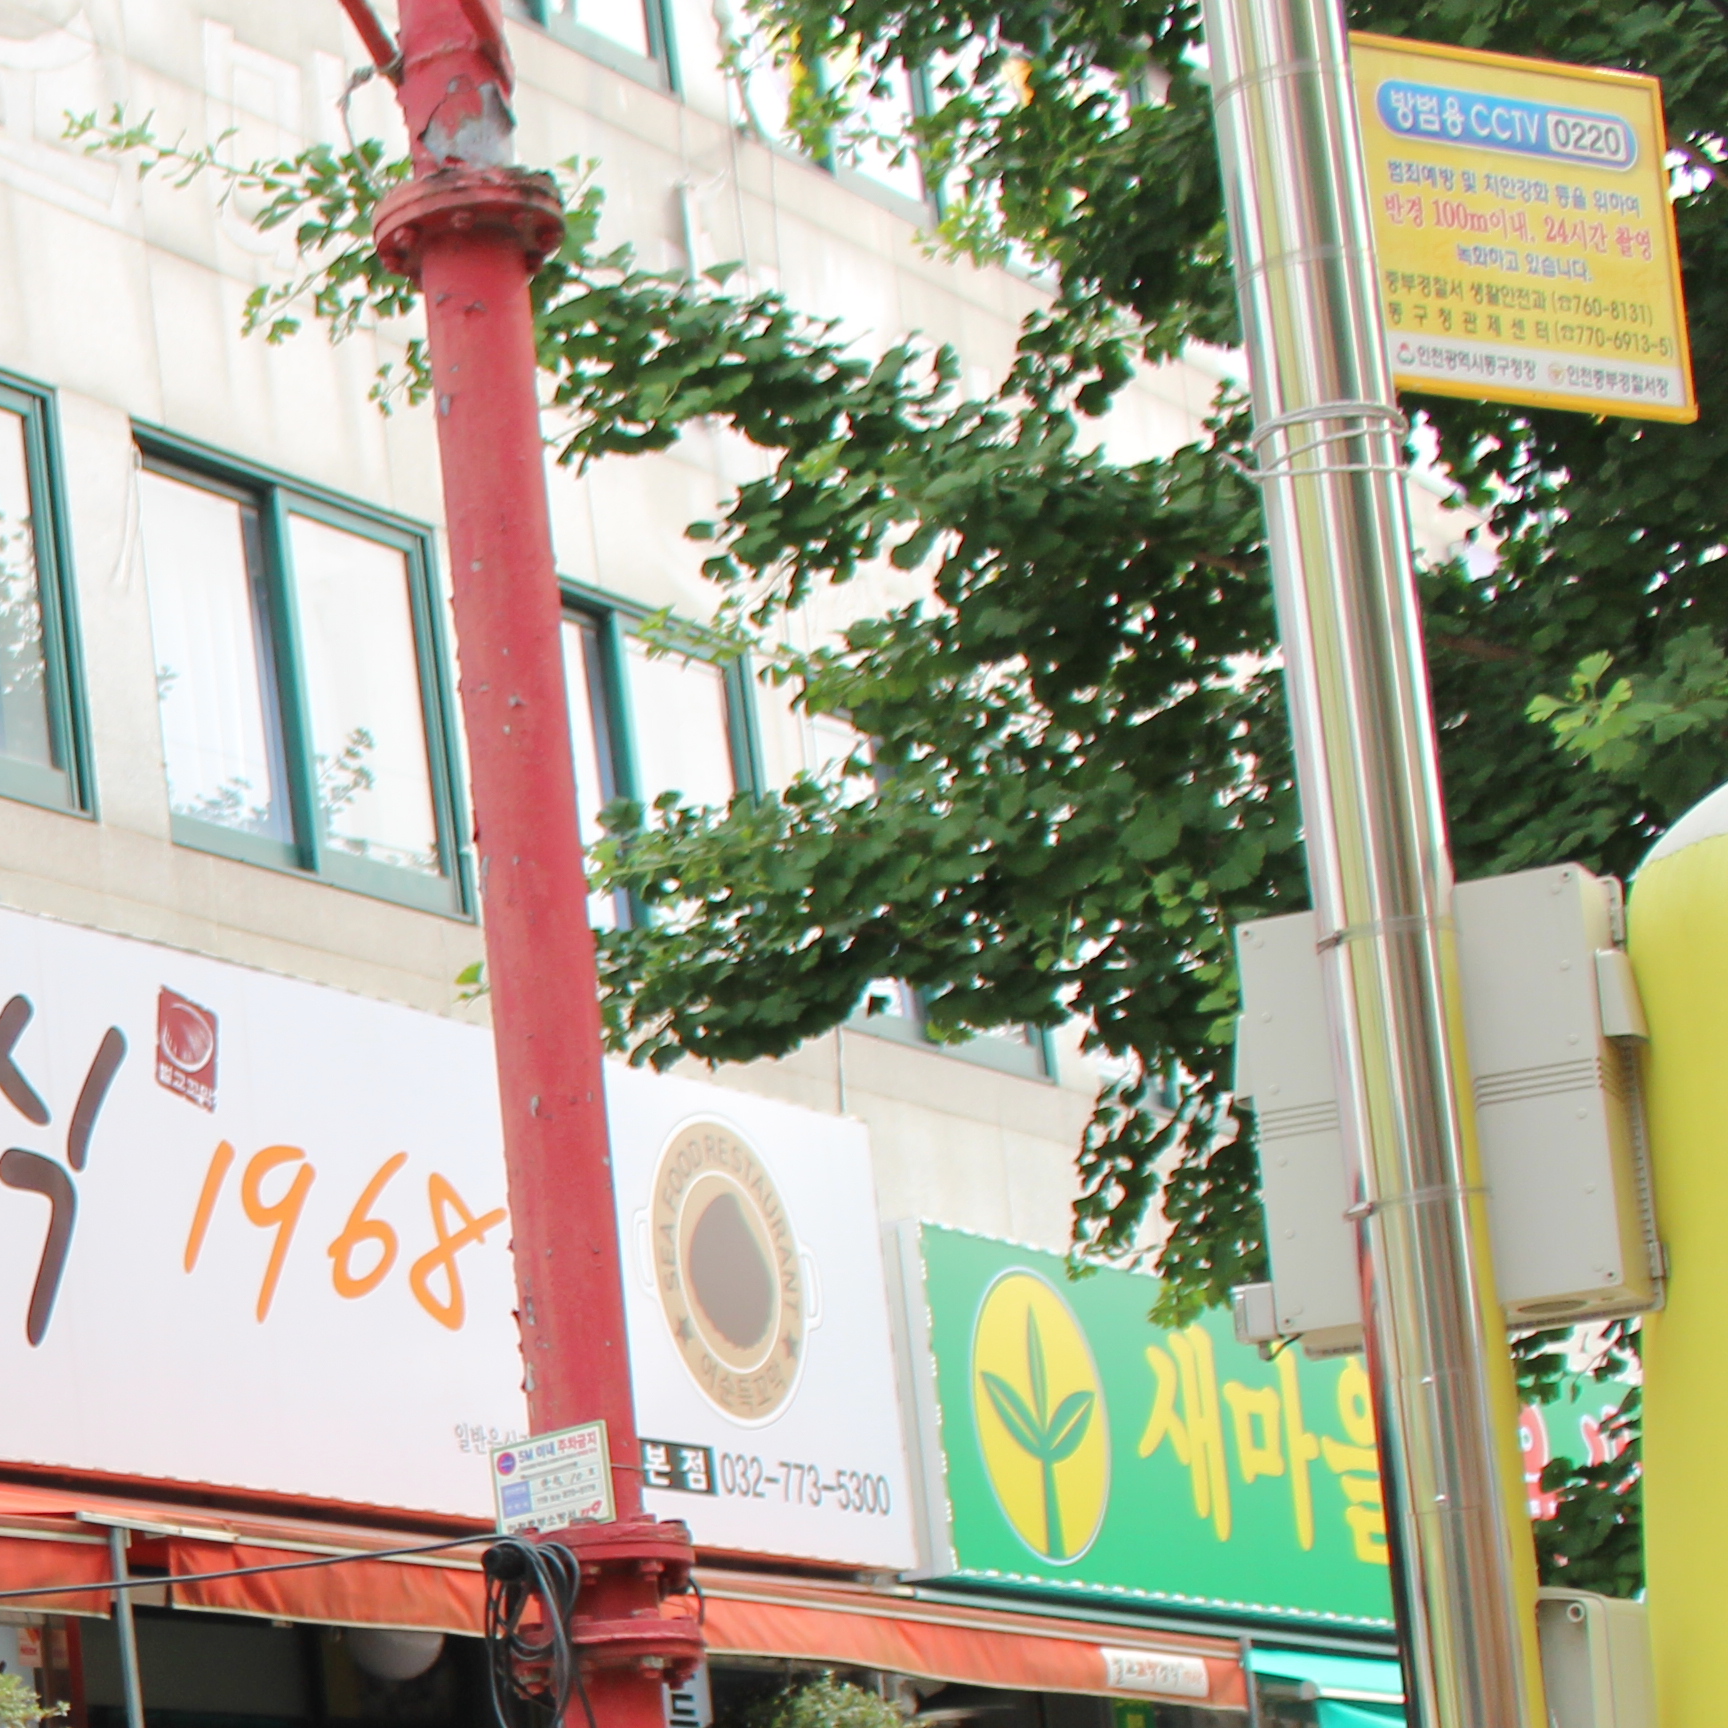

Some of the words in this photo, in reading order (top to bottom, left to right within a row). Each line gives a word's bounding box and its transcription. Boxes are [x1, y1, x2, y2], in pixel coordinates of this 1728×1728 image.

[1390, 89, 1465, 138] 방범용
[1470, 104, 1539, 144] CCTV
[1552, 119, 1622, 156] 0220
[1387, 160, 1455, 191] 범죄예방
[1461, 170, 1478, 195] 및
[1483, 174, 1549, 205] 치안강화
[1555, 185, 1587, 211] 등을
[1593, 191, 1641, 218] 위하여
[1384, 194, 1424, 229] 반경
[1544, 216, 1608, 254] 24시간
[1614, 227, 1653, 261] 촬영
[1384, 270, 1464, 301] 중부경찰서
[1469, 279, 1547, 311] 생활안전과
[1456, 243, 1520, 273] 녹화하고
[1525, 253, 1594, 283] 있습니다.
[663, 1140, 704, 1212] FOOD
[184, 1138, 508, 1331] 1968
[659, 1223, 681, 1292] SEA
[704, 1134, 800, 1319] RESTAURANT
[556, 1430, 598, 1453] 주차금지
[1138, 1323, 1394, 1565] 새마을
[644, 1443, 710, 1493] 본점
[720, 1451, 891, 1517] 032-773-5300
